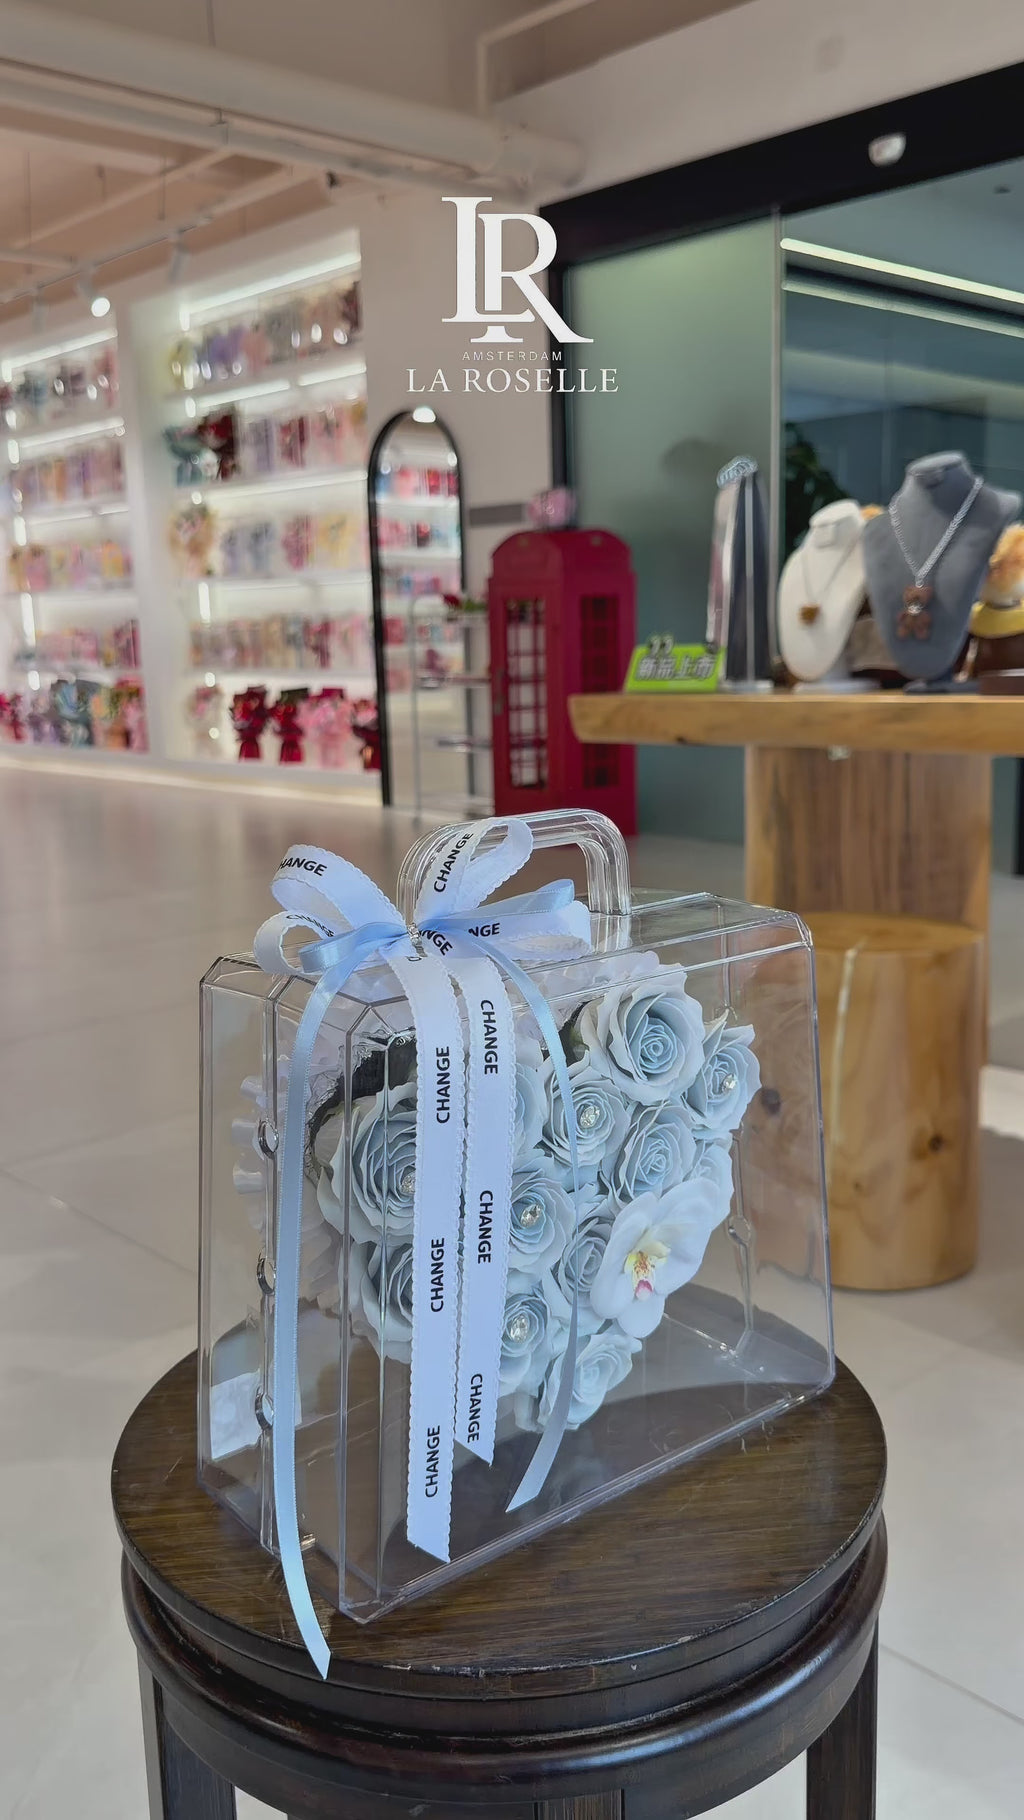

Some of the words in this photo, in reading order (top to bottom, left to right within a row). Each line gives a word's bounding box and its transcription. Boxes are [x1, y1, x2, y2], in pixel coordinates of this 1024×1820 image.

[637, 654, 716, 680] 新品上市
[433, 833, 474, 893] CHANGE
[480, 999, 498, 1075] CHANGE
[436, 1046, 450, 1124] CHANGE
[478, 1190, 493, 1264] CHANGE
[431, 1237, 445, 1313] CHANGE
[467, 1373, 483, 1443] CHANGE
[425, 1425, 440, 1498] CHANGE
